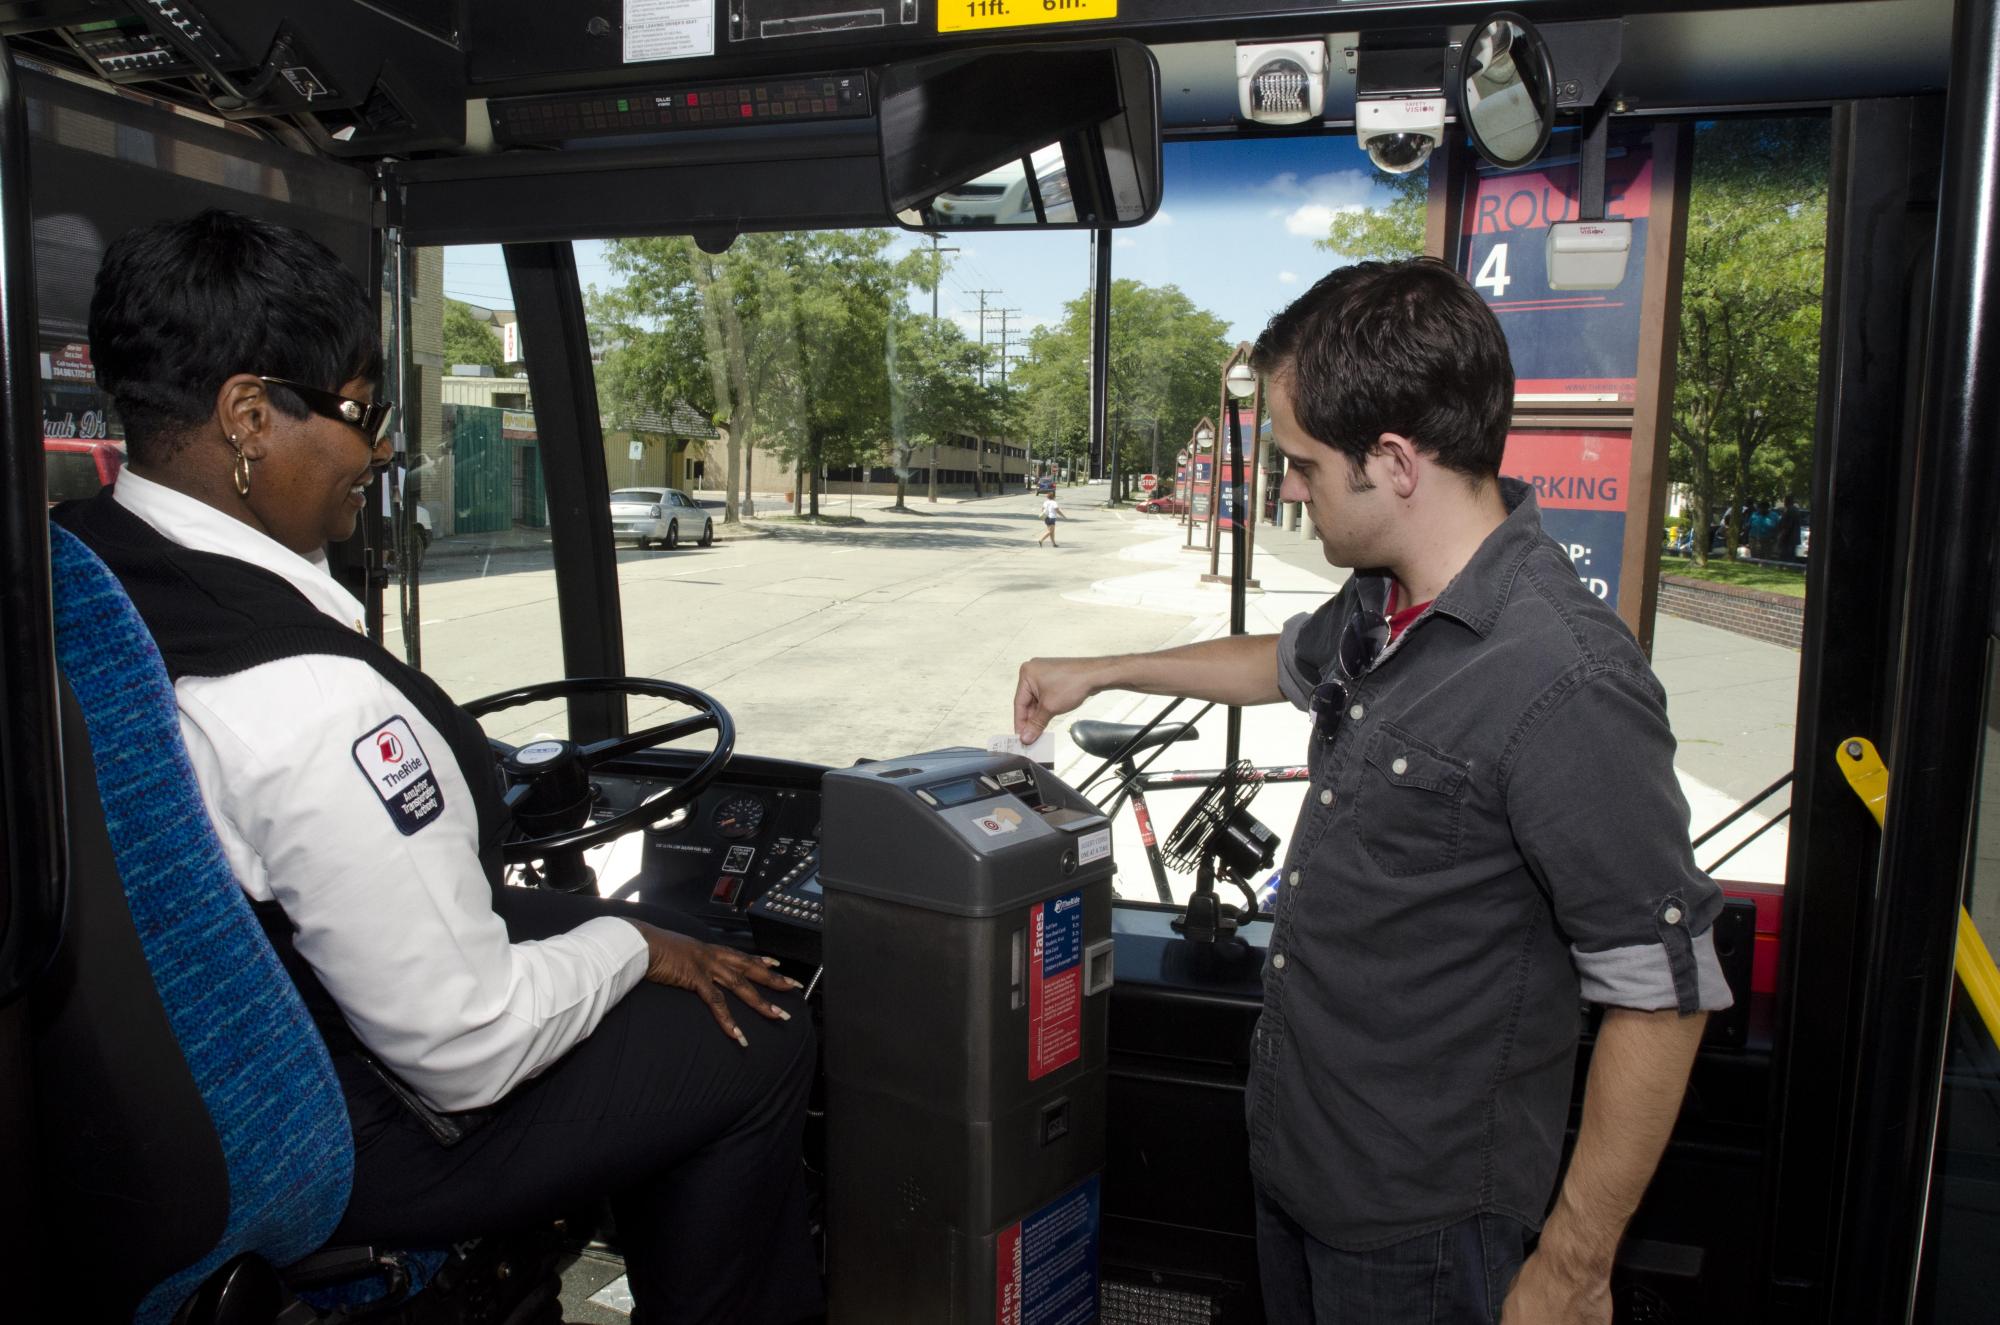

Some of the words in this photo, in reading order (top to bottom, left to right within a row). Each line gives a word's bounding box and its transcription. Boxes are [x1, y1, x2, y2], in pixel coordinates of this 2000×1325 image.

[967, 0, 1010, 17] 11ft.
[1478, 187, 1625, 233] ROUE
[1475, 243, 1511, 297] 4
[43, 409, 77, 439] ank
[1515, 475, 1617, 501] RKING
[382, 757, 422, 788] TheRide
[1033, 912, 1043, 957] Fares
[1012, 1236, 1021, 1299] Available
